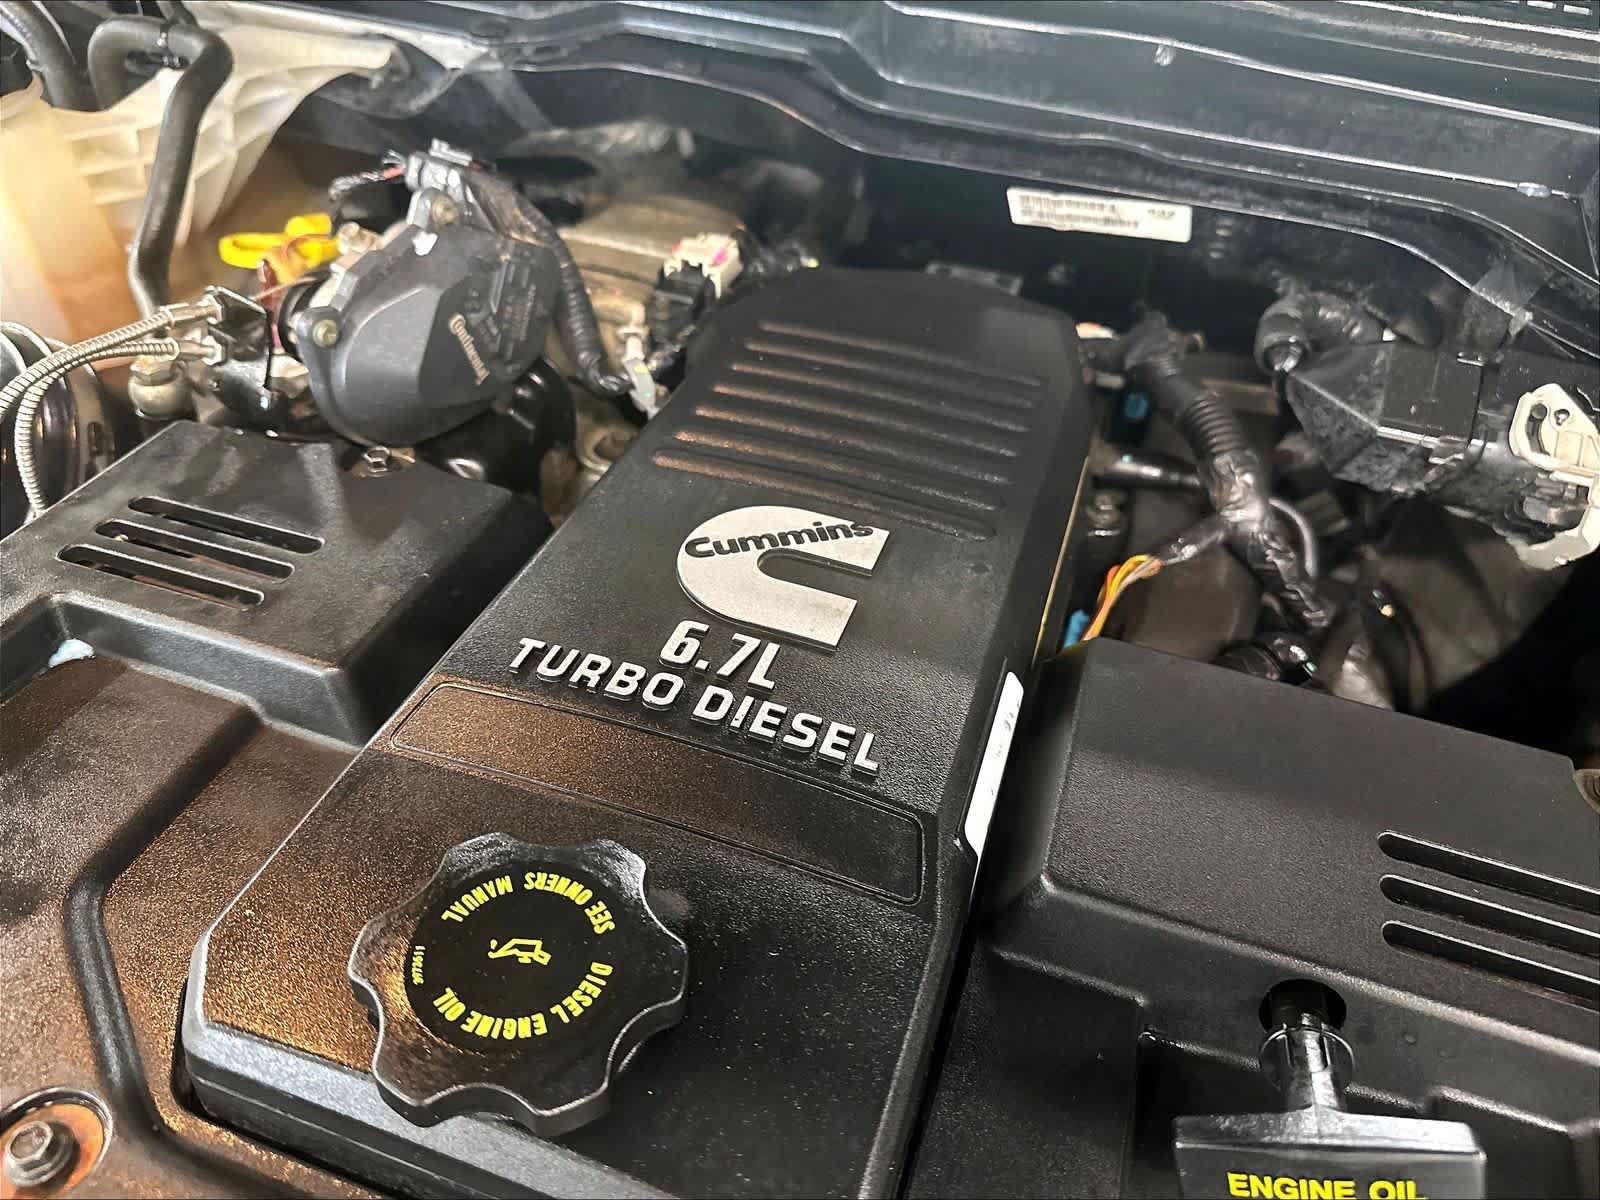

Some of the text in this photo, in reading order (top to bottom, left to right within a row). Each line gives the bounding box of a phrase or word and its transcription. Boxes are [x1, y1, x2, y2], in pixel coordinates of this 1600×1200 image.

[684, 521, 874, 559] Cummins
[659, 619, 781, 691] 6.7L
[508, 637, 880, 776] TURBO DIESEL
[440, 871, 616, 934] SEE OWNERS MANUAL
[432, 961, 614, 1041] DIESEL ENGINE OIL
[1227, 1172, 1429, 1200] ENGINE OIL
